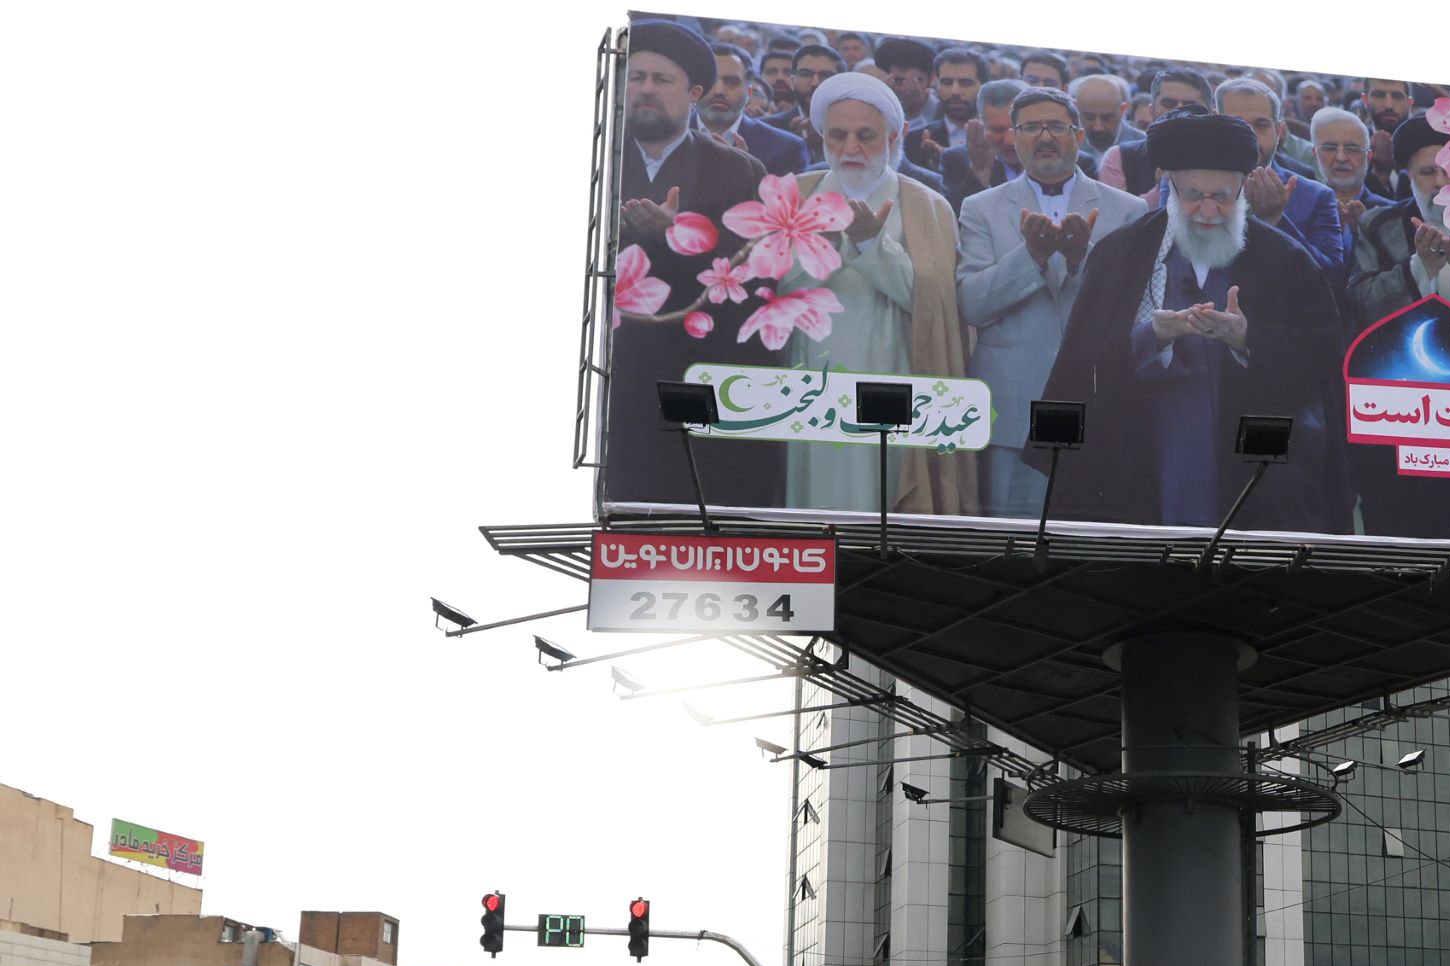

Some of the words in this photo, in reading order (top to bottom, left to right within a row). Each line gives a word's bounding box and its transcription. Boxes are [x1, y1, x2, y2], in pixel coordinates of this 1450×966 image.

[1352, 394, 1431, 426] است
[925, 405, 981, 454] عید
[1404, 452, 1419, 466] باد
[1421, 453, 1450, 470] مبارک
[600, 543, 668, 570] نوین
[670, 545, 733, 571] ایران
[736, 547, 827, 573] کانون
[629, 591, 795, 623] 27634
[111, 827, 140, 850] مادر
[142, 838, 170, 860] خرید
[172, 841, 203, 868] مرکز
